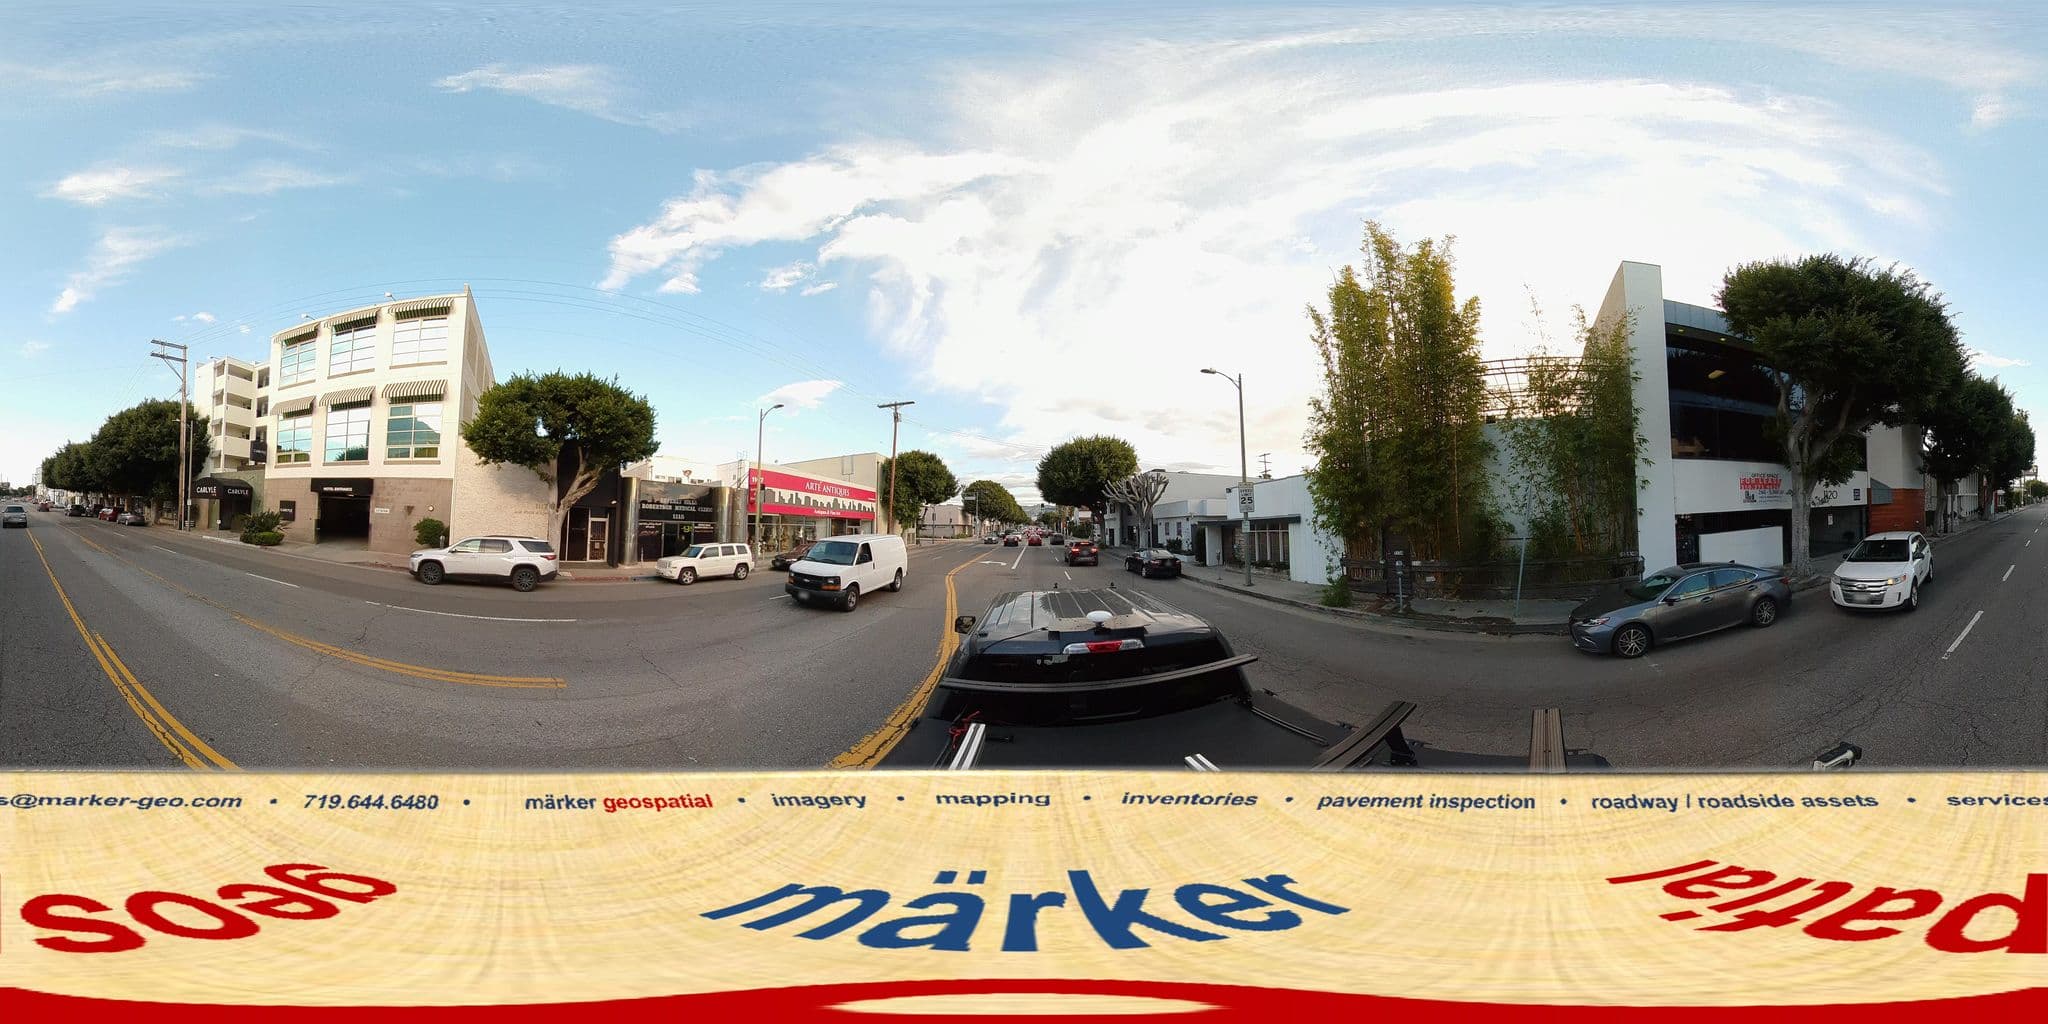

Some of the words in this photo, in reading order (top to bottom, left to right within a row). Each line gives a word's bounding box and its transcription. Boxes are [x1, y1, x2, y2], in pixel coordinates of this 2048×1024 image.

[196, 486, 217, 494] CARLYLE
[822, 485, 850, 496] ANTIQUES
[1240, 496, 1253, 504] 25
[641, 503, 673, 511] ROBERTSON
